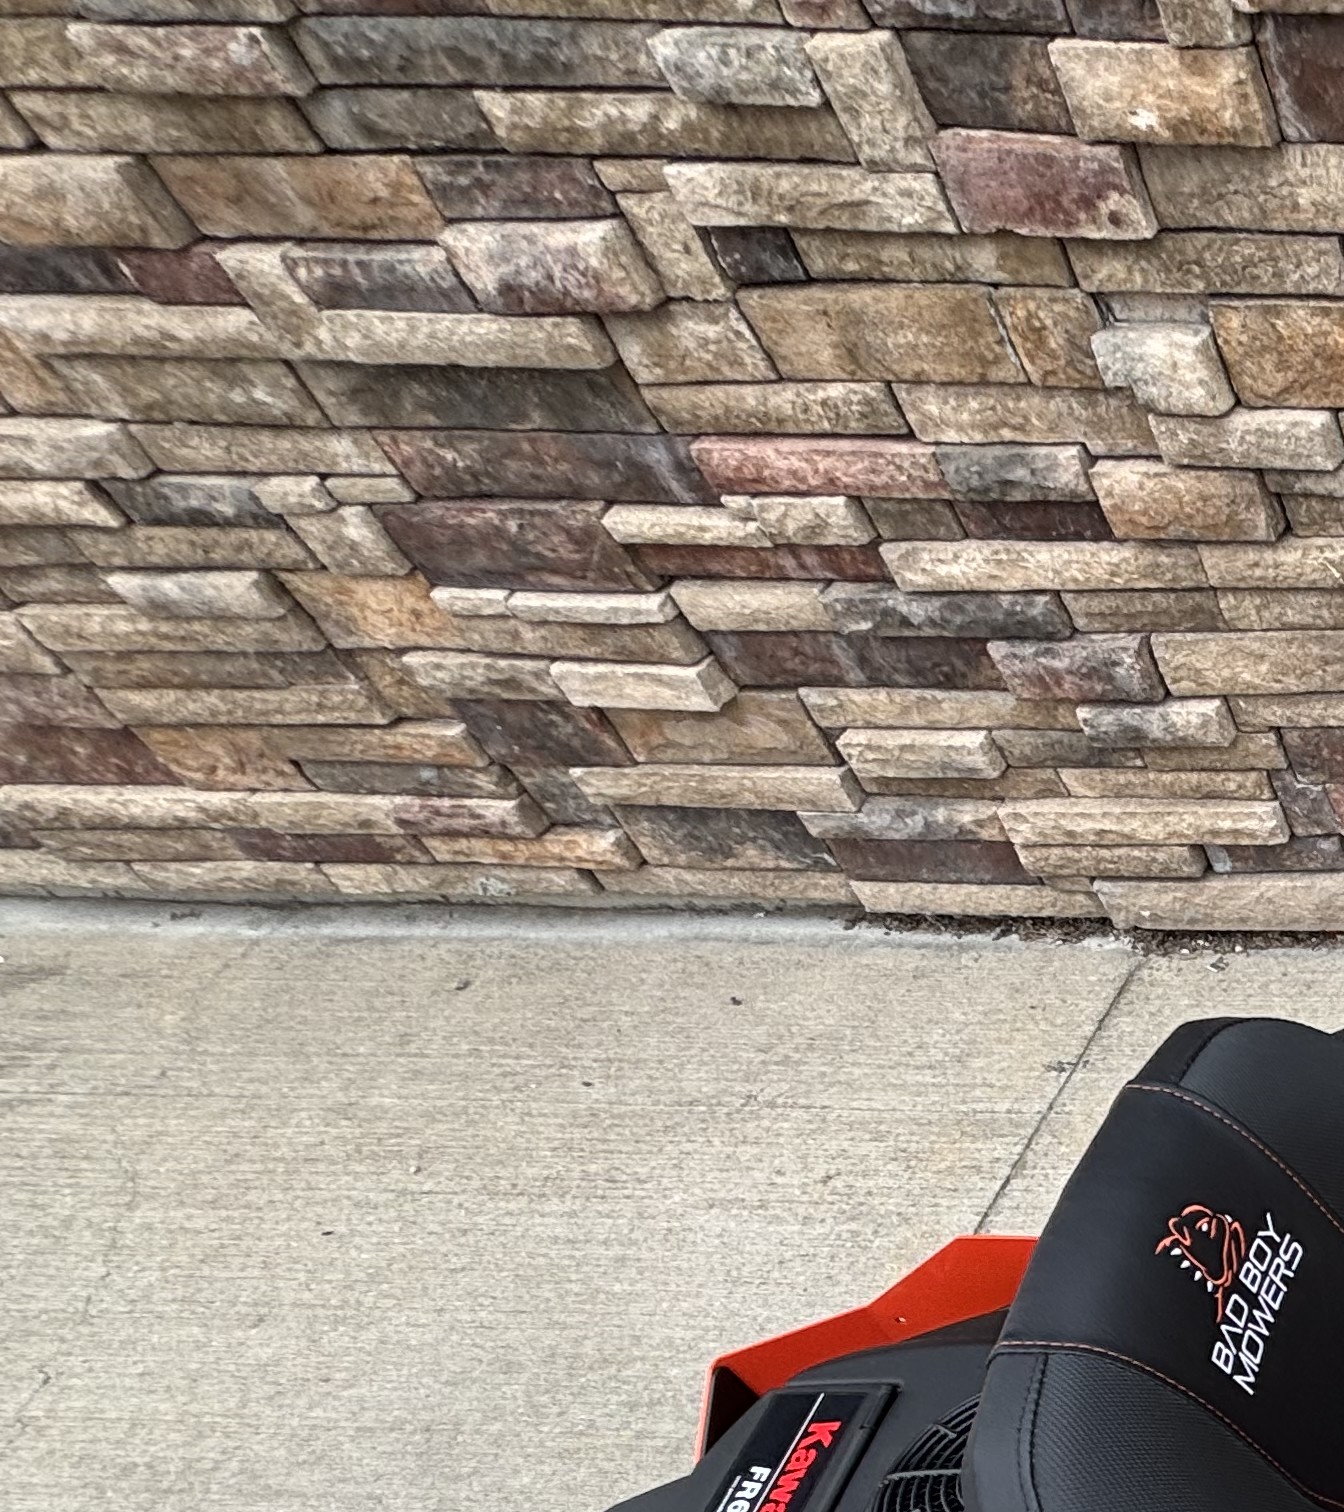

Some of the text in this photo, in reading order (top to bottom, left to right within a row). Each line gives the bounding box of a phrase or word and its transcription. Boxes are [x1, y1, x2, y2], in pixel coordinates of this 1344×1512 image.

[1211, 1211, 1282, 1375] BAD BOY
[1232, 1232, 1304, 1396] MOWERS
